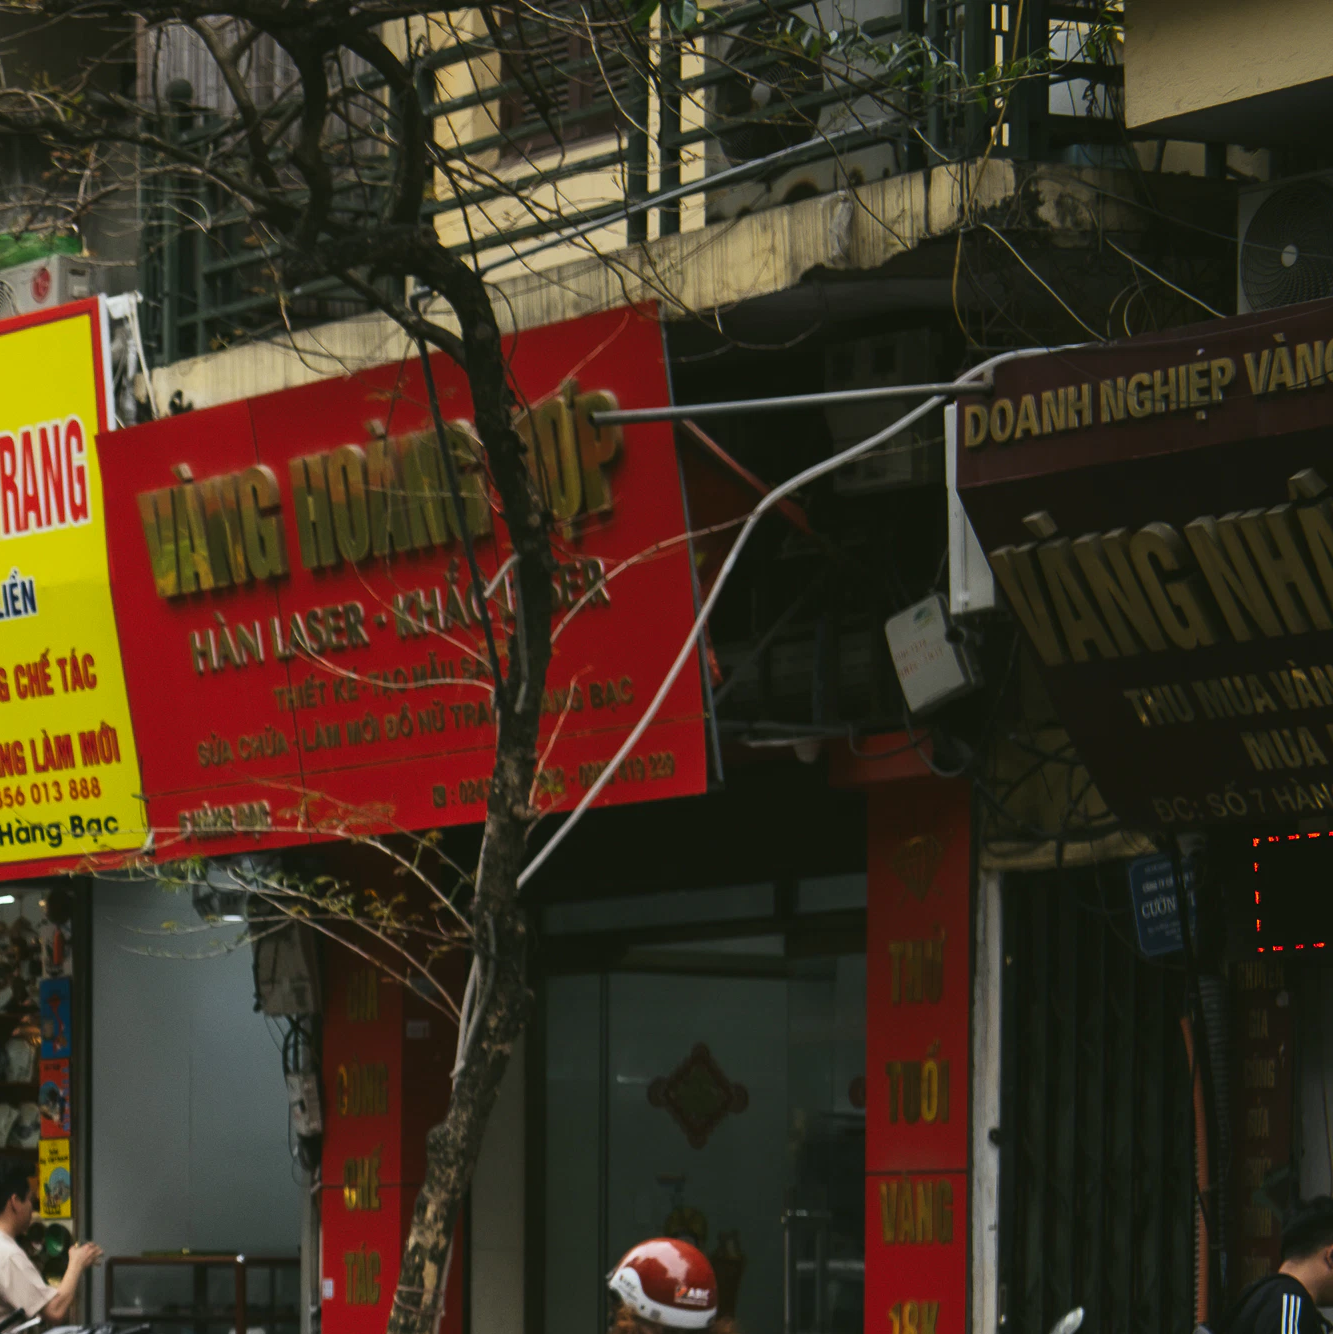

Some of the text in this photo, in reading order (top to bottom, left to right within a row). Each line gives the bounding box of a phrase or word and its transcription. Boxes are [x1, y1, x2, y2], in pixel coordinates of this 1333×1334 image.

[964, 383, 1093, 449] DOANH
[1100, 348, 1237, 424] NGHIỆP
[136, 462, 289, 598] VÀNG
[289, 417, 494, 570] HOÀNG
[190, 612, 265, 674] HÀN
[269, 602, 369, 660] LASER
[392, 558, 485, 638] KHẮC
[501, 557, 611, 619] LER
[989, 510, 1217, 667] VÀNG
[14, 648, 55, 701] CHẾ
[58, 652, 98, 693] TÁC
[273, 674, 327, 713] THIẾT
[331, 666, 360, 702] KẾ
[370, 667, 409, 705] TẠO
[1123, 683, 1194, 728] THU
[1191, 673, 1279, 721] MUA
[31, 727, 74, 775] LÀM
[79, 718, 121, 768] MỚI
[198, 730, 234, 767] SỬA
[237, 725, 289, 760] CHỮA
[301, 720, 342, 752] LÀM
[346, 710, 381, 745] MỚI
[416, 698, 446, 735] NỮ
[589, 678, 633, 719] BẠC
[1240, 726, 1329, 772] MUA
[30, 781, 63, 807] 013
[66, 775, 101, 803] 888
[1271, 776, 1333, 812] HÀN
[66, 811, 120, 846] Bạc
[1141, 893, 1179, 920] CƯỜN
[879, 1174, 955, 1248] VÀNG
[344, 1241, 382, 1306] TÁC
